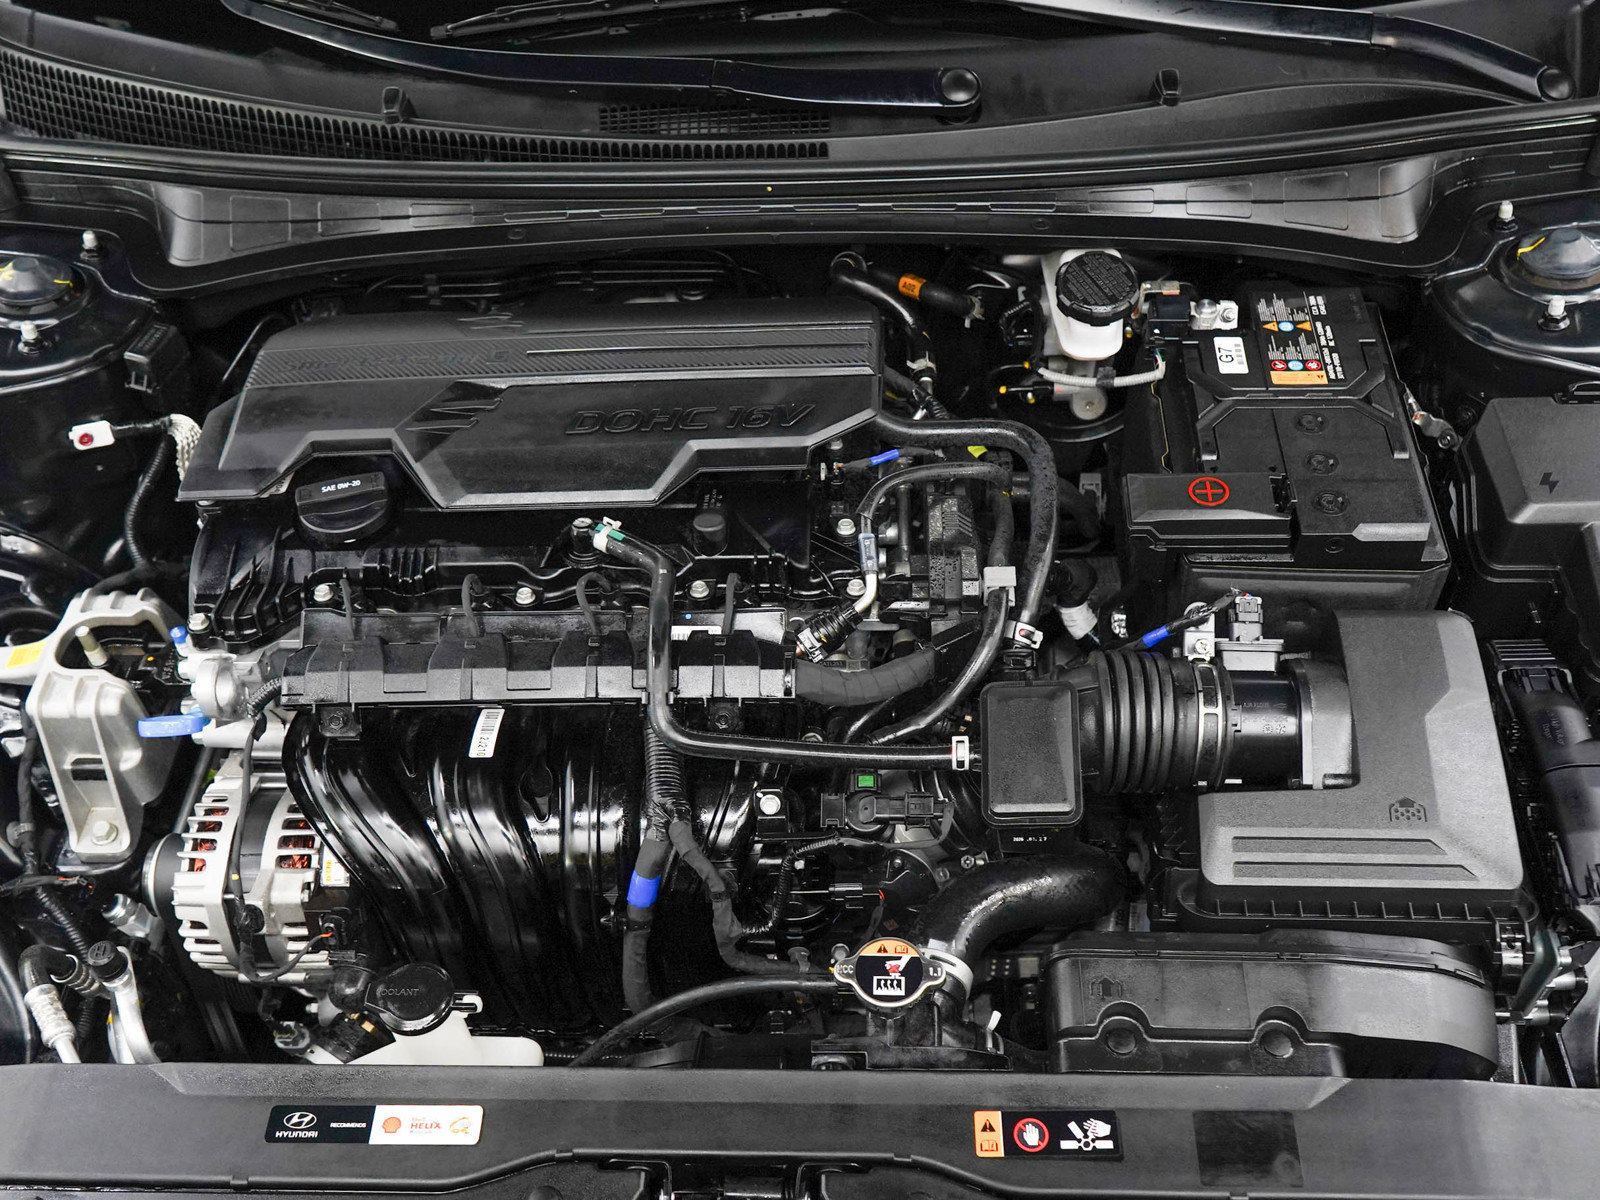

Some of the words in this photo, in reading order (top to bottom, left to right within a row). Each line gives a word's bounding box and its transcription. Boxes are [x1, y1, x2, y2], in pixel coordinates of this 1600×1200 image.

[1219, 346, 1235, 364] G7
[565, 406, 717, 434] DOHC
[726, 403, 816, 429] 16V
[321, 484, 337, 493] SAE
[337, 479, 361, 490] 0W-20
[377, 988, 420, 996] OOLANT
[410, 1120, 441, 1130] HELIX
[275, 1130, 319, 1139] HYUNDAI
